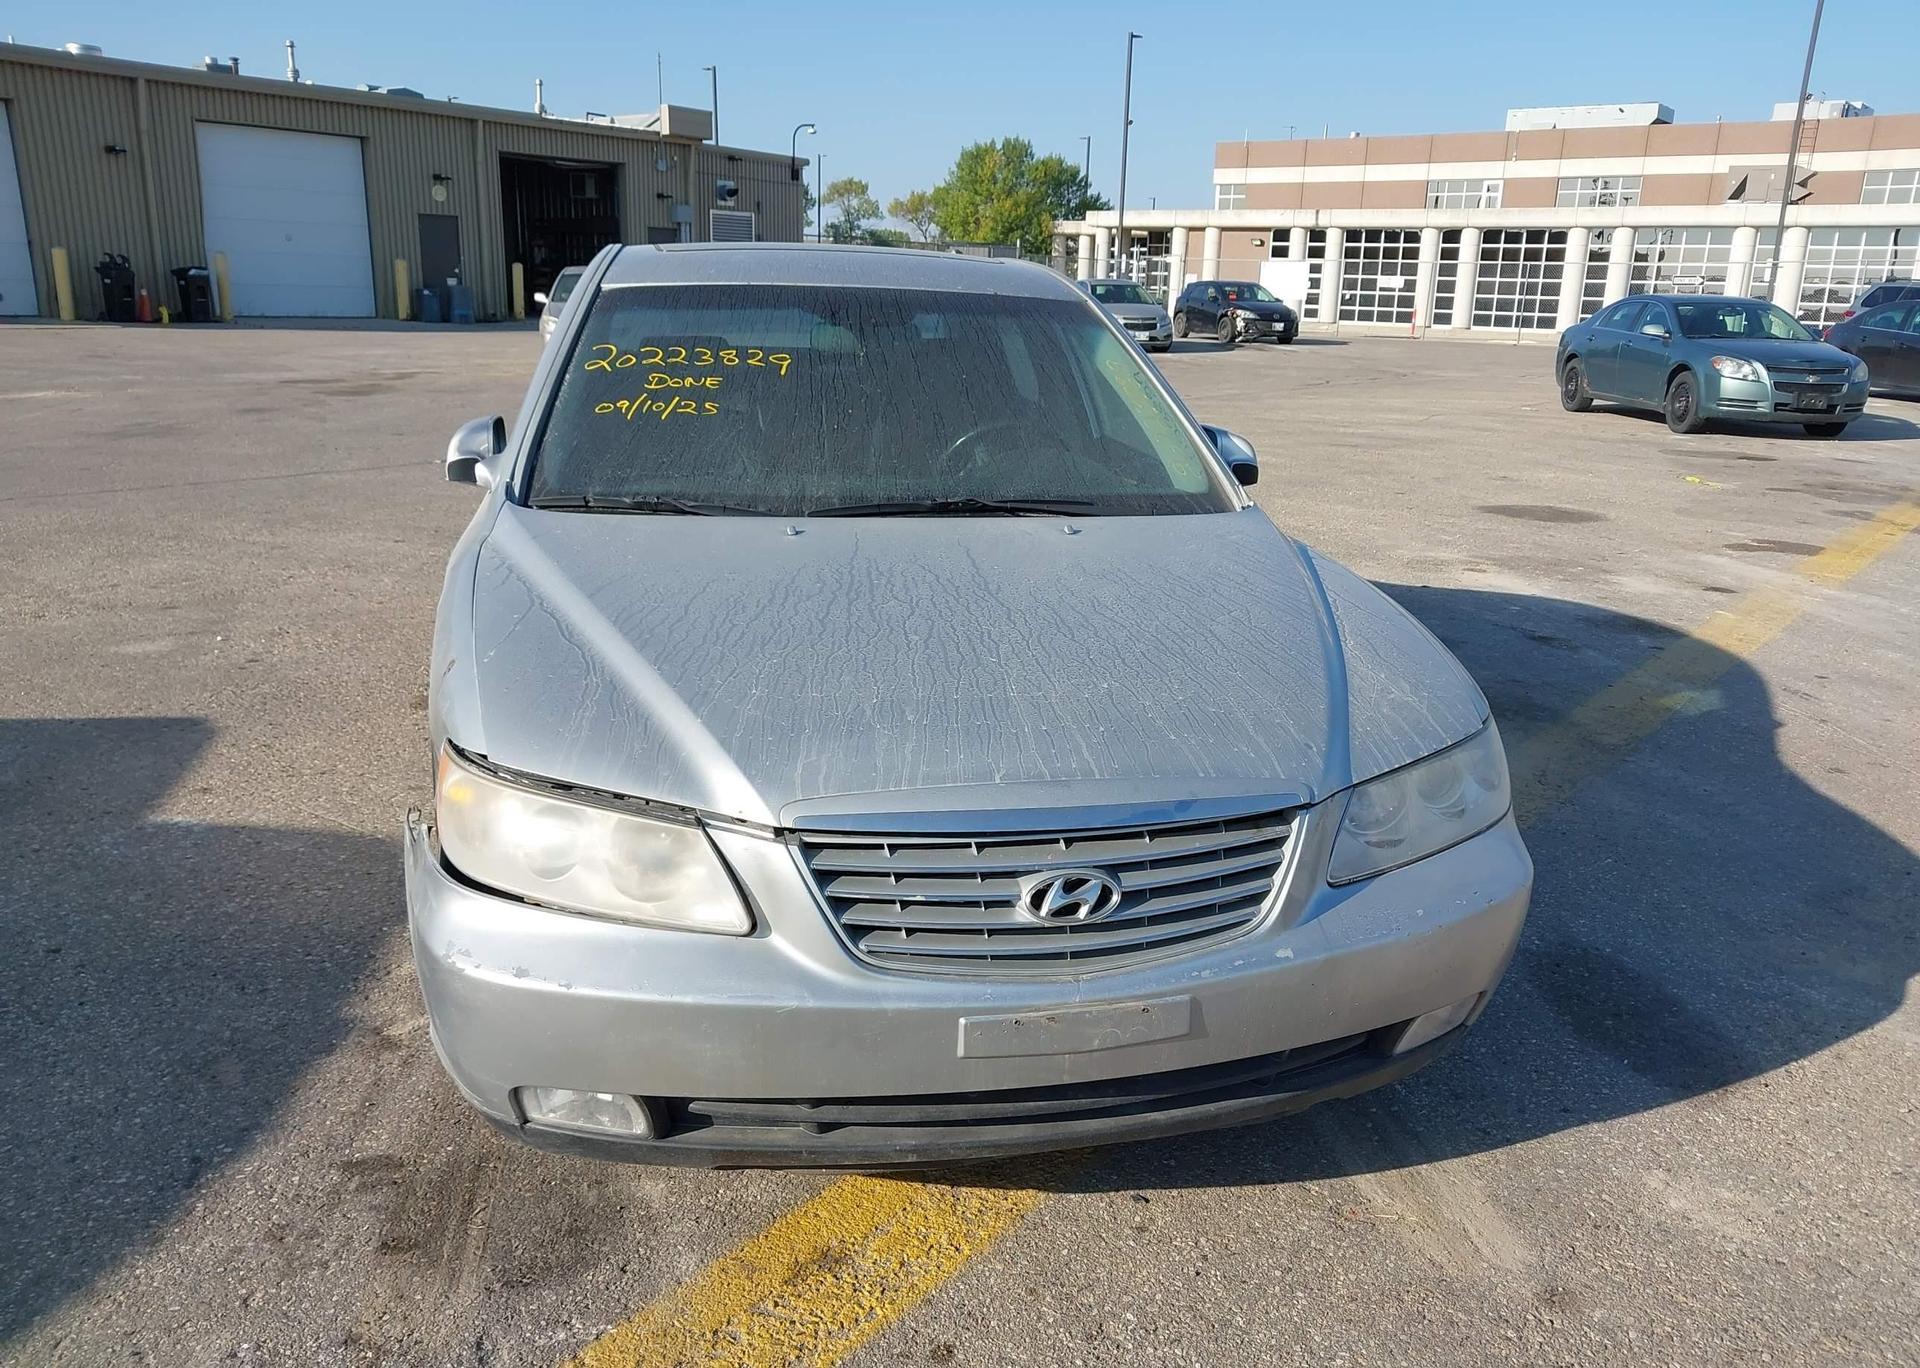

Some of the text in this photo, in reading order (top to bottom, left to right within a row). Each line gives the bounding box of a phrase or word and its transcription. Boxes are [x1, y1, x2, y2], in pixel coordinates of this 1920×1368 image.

[585, 344, 792, 375] 20223829
[644, 373, 724, 389] DONE
[595, 393, 719, 420] 09/10/25
